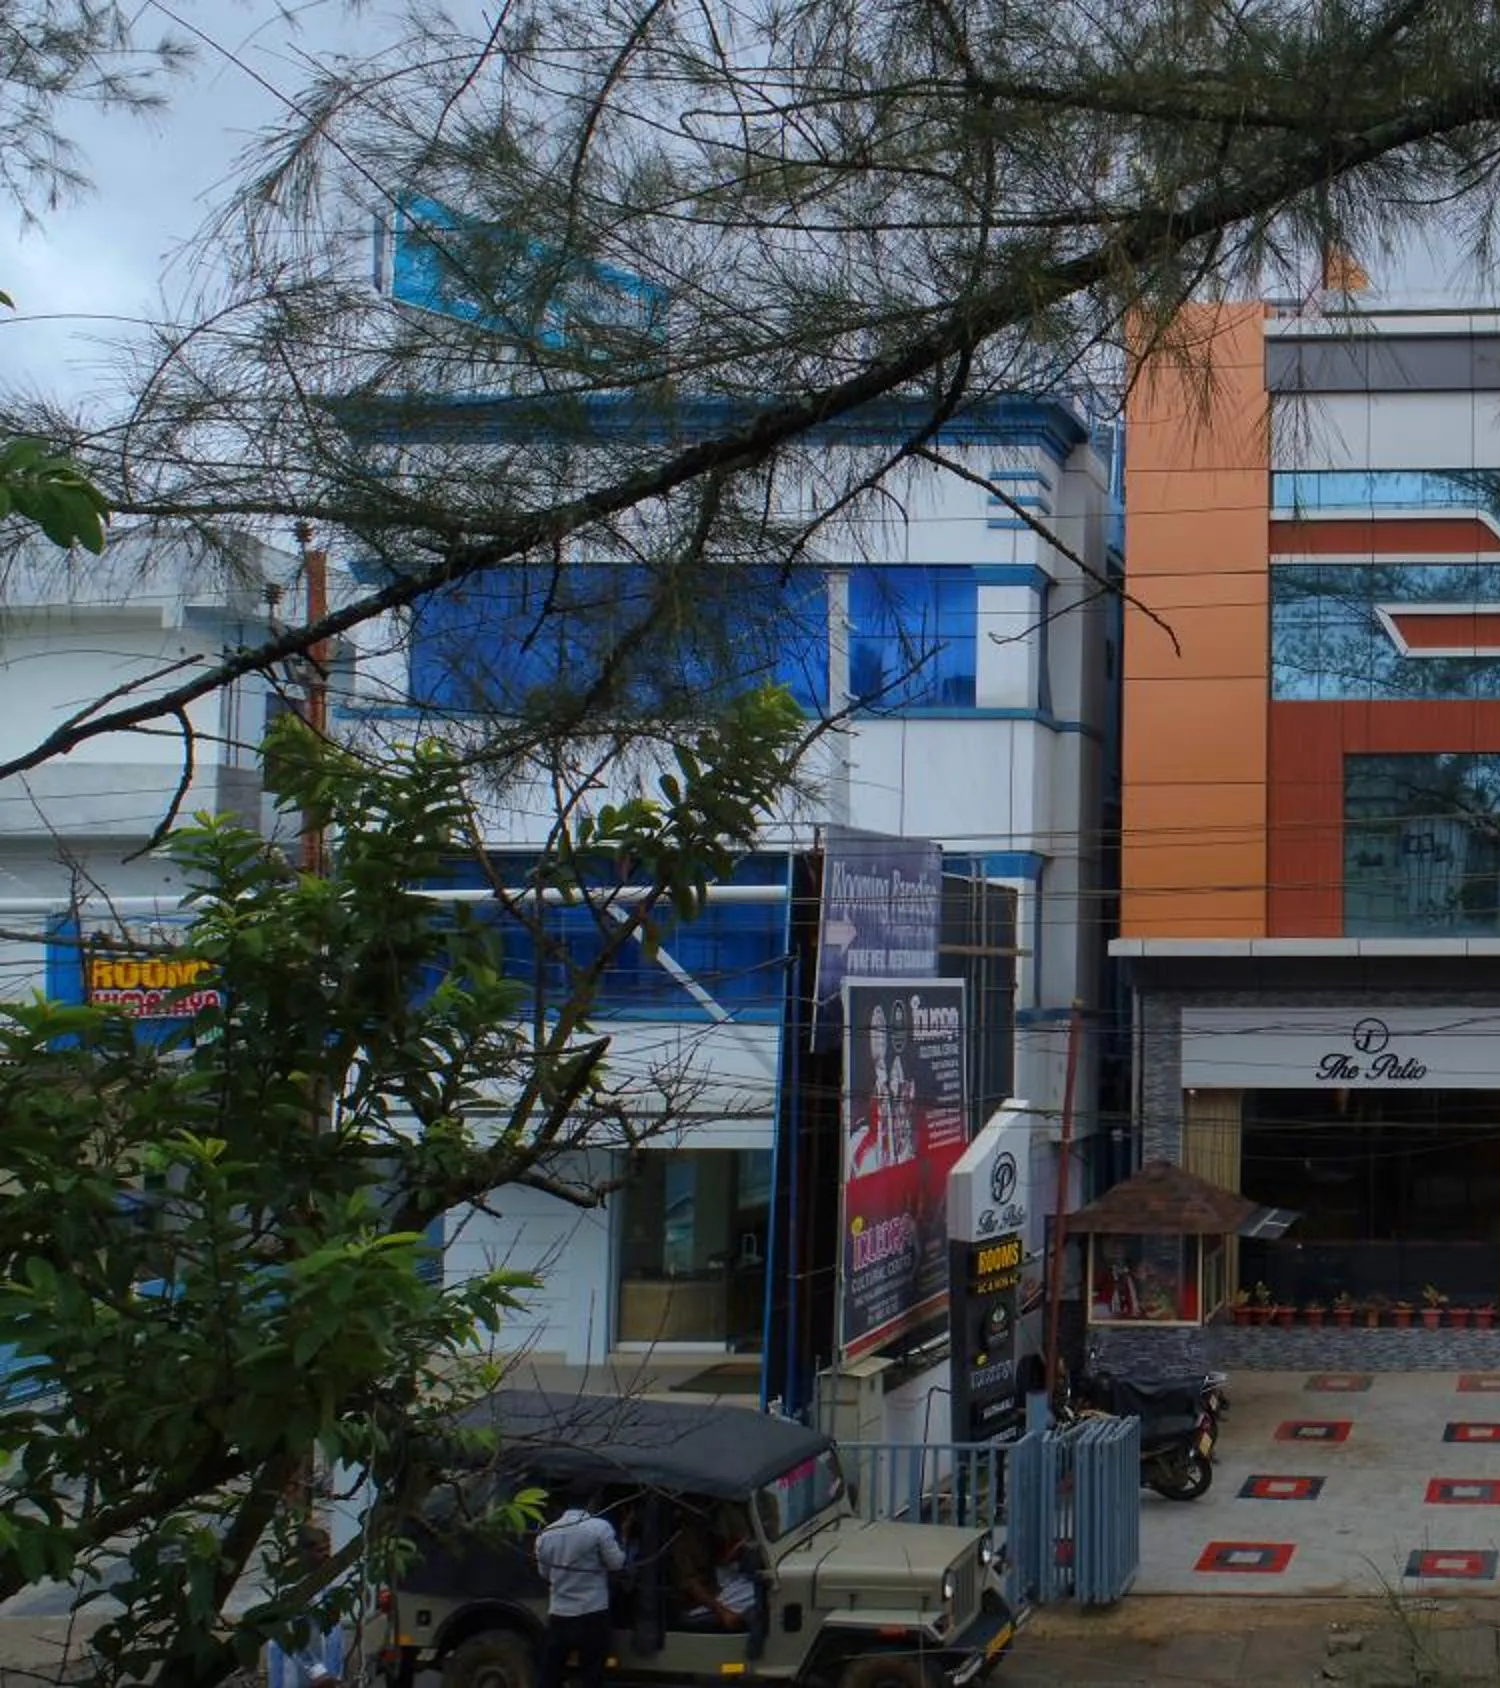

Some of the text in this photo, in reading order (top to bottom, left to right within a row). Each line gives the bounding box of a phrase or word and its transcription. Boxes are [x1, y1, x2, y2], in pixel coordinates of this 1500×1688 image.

[91, 959, 220, 989] ROOM
[1315, 1053, 1427, 1080] The Patio
[978, 1242, 1019, 1275] ROOMS
